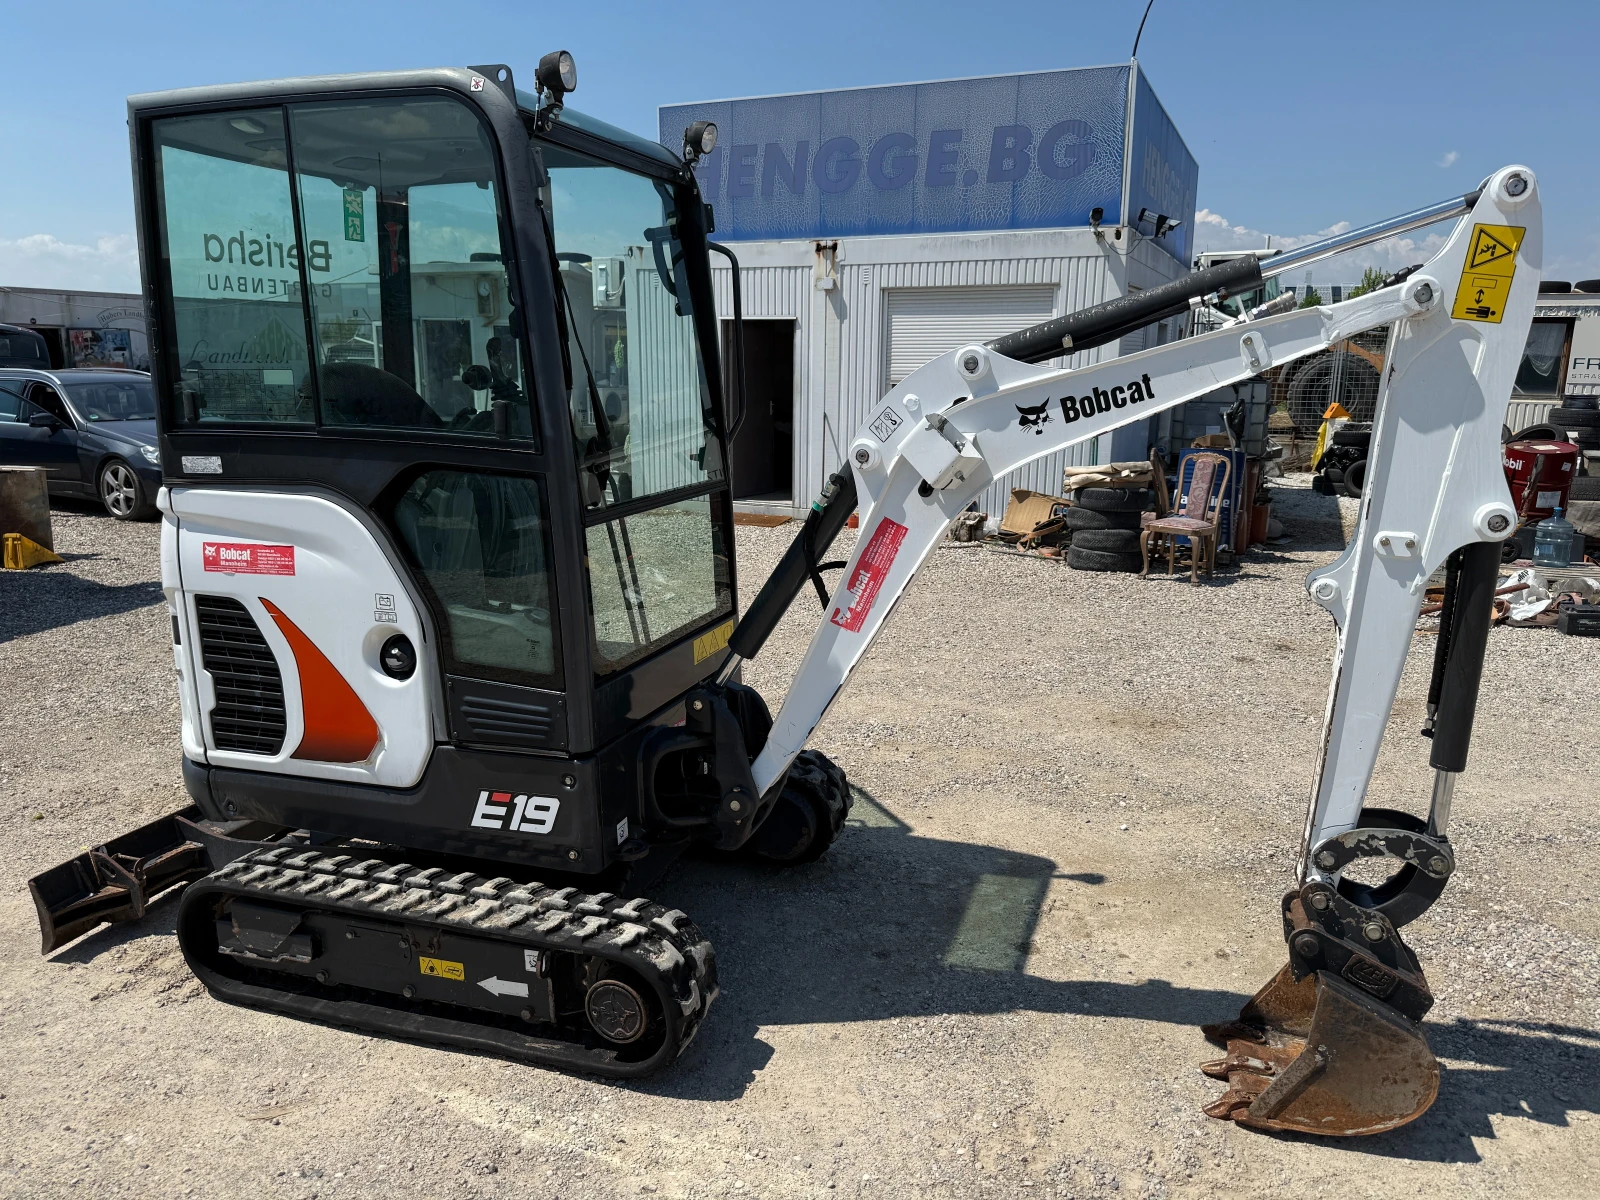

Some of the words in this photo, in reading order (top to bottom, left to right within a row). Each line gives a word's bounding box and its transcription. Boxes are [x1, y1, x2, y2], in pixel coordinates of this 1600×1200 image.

[1059, 373, 1156, 424] Bobcat
[1503, 455, 1523, 471] obil
[219, 547, 251, 560] Bobcat
[855, 580, 875, 612] Mannheim
[470, 789, 561, 835] E19
